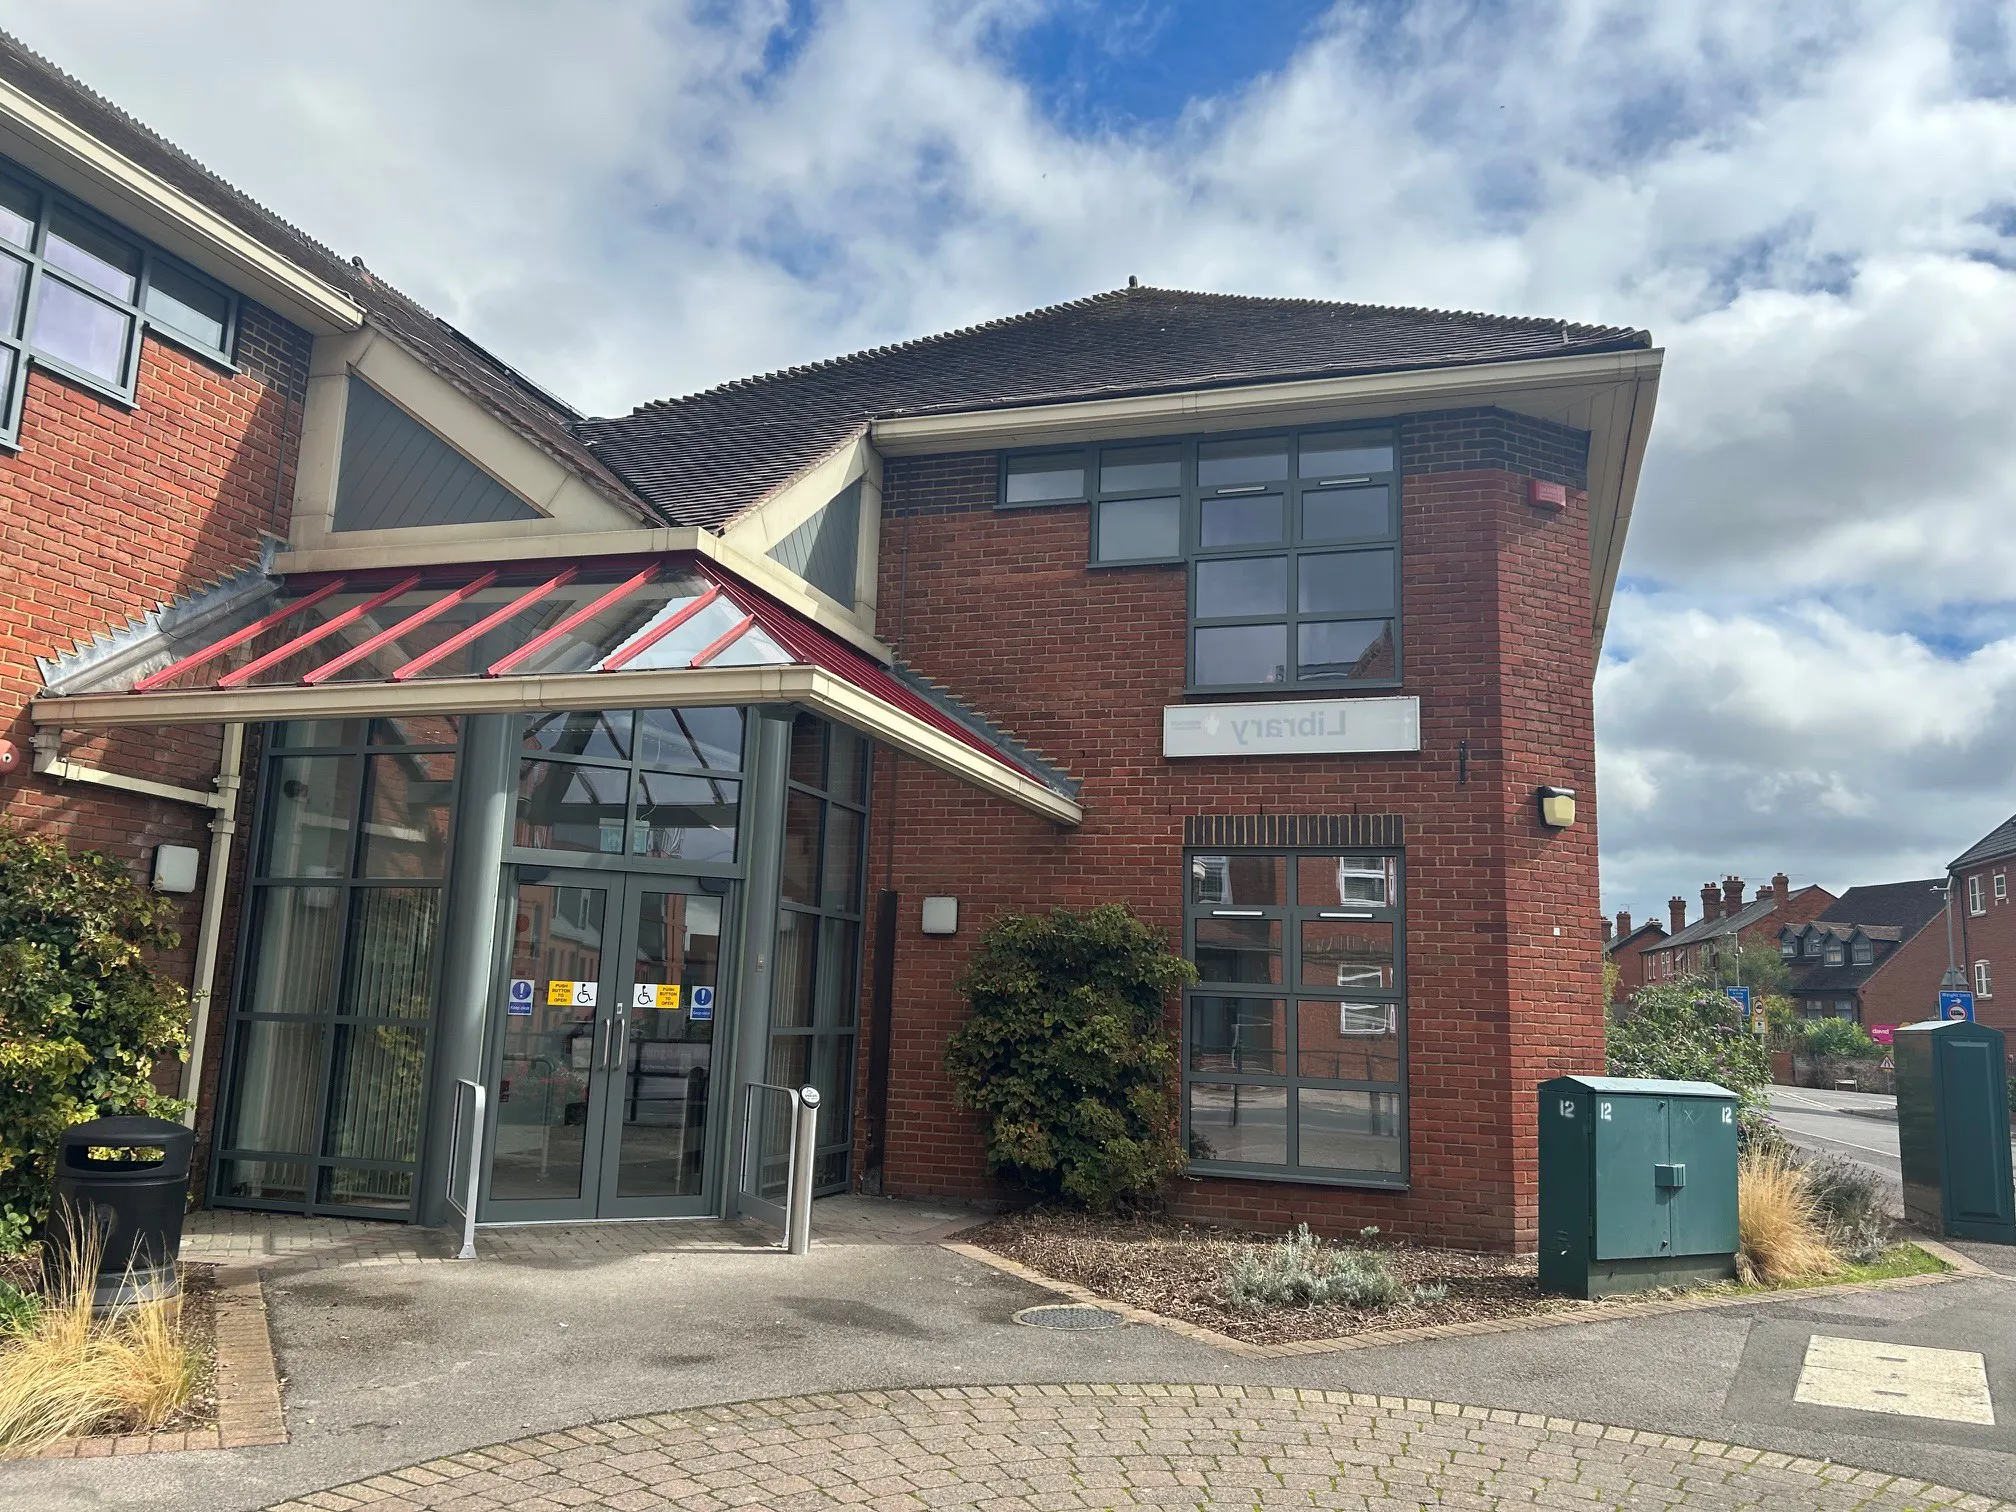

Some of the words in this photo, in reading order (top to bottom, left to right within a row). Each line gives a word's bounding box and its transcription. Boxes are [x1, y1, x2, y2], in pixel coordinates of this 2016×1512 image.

[1559, 1100, 1575, 1118] 12
[1600, 1102, 1612, 1122] 12
[1721, 1107, 1732, 1124] 12
